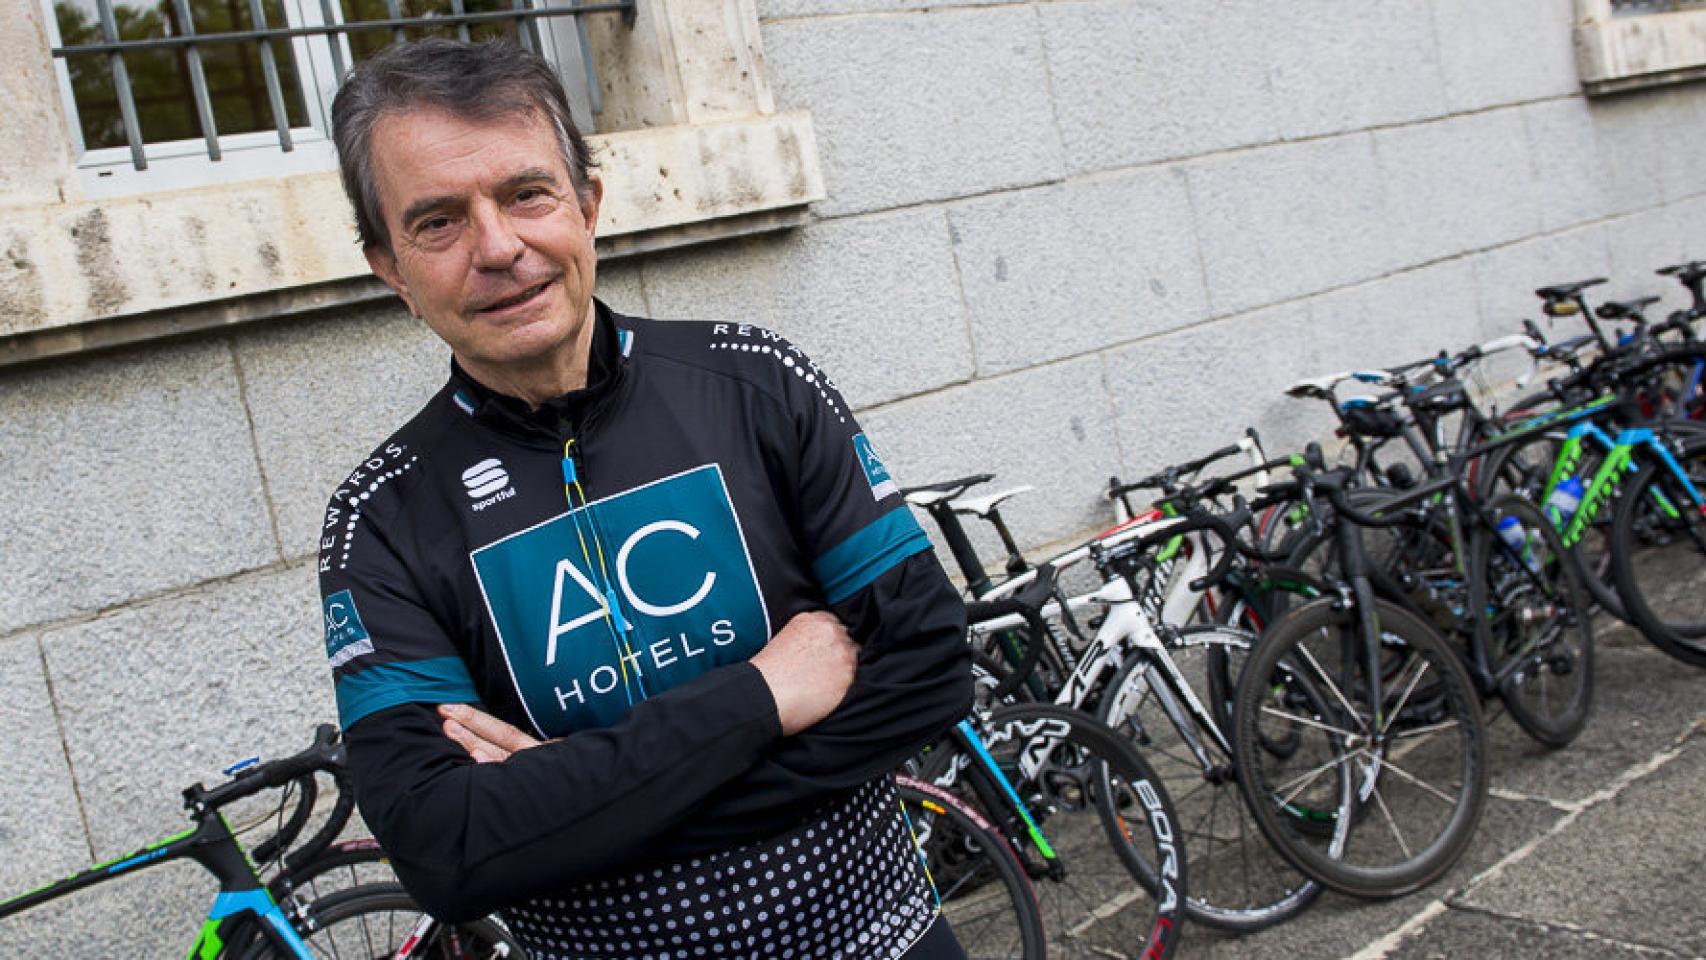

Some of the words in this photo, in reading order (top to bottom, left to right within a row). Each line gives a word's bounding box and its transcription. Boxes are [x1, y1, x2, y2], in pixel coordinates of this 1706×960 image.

[471, 486, 516, 511] sportful
[545, 519, 717, 667] AC
[554, 619, 736, 711] HOTELS
[1131, 778, 1179, 913] BORA
